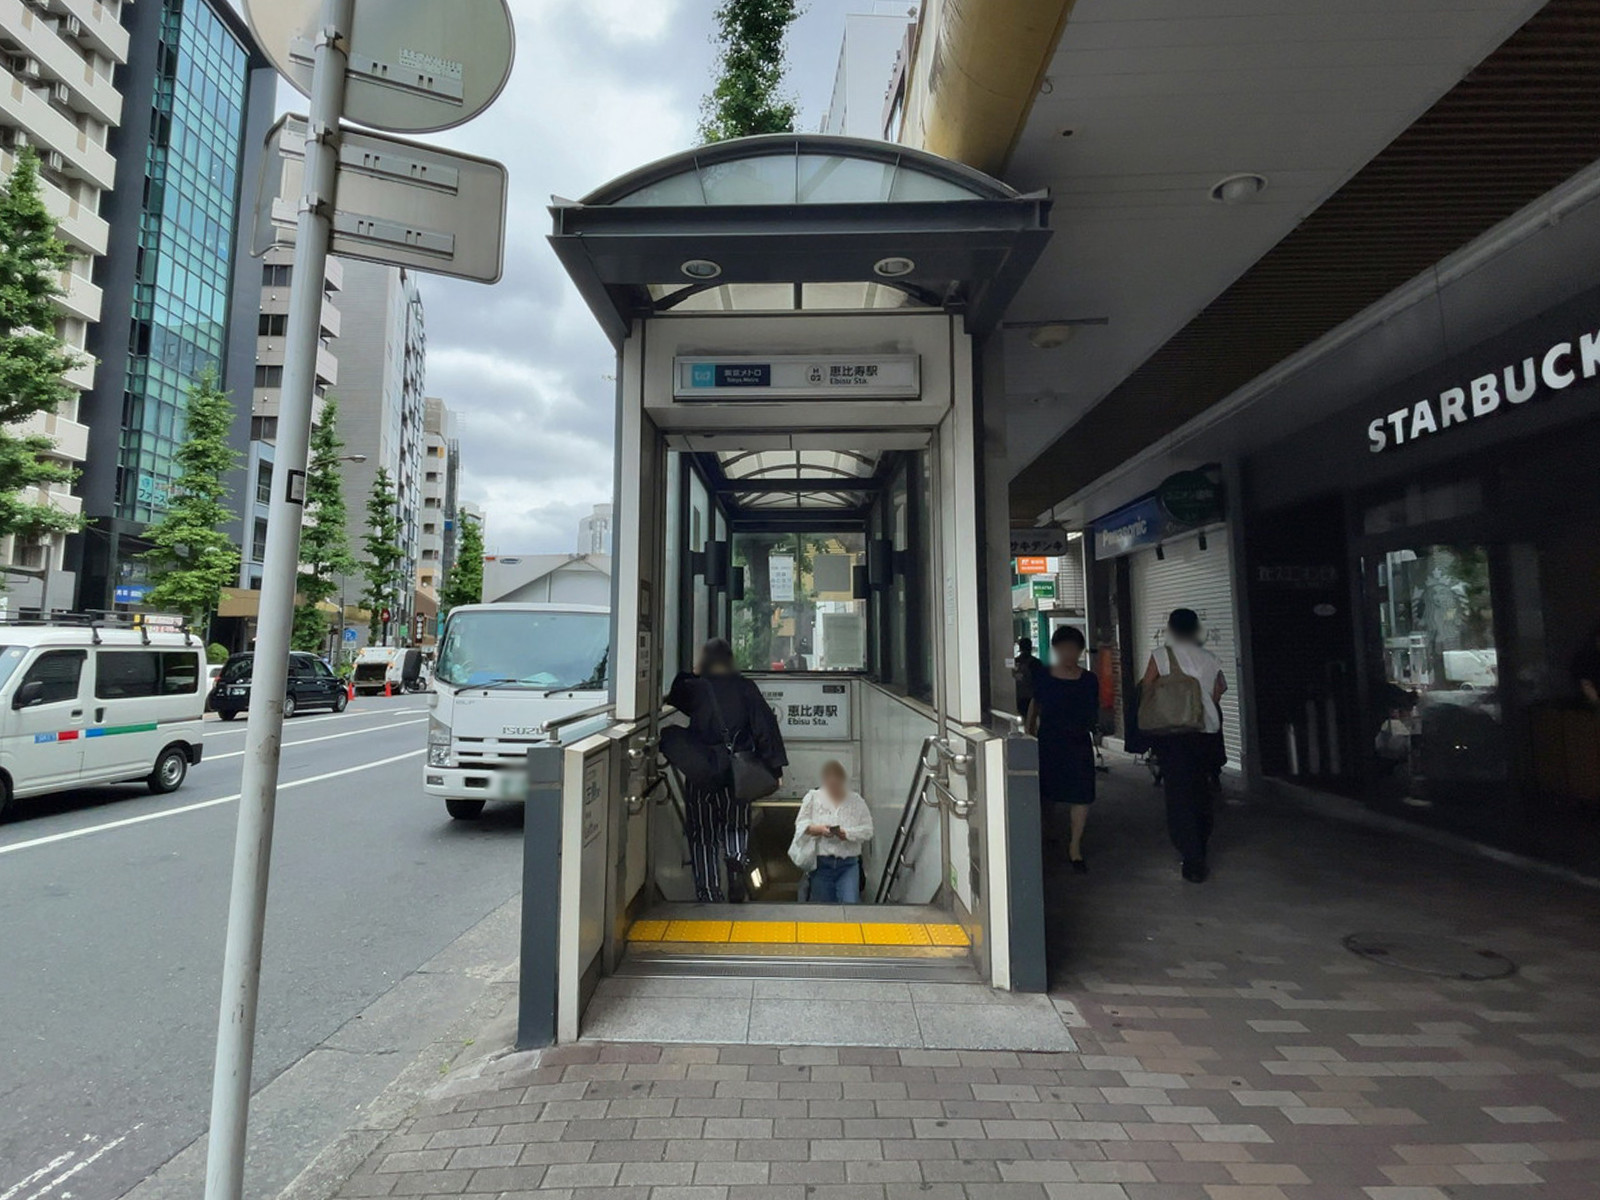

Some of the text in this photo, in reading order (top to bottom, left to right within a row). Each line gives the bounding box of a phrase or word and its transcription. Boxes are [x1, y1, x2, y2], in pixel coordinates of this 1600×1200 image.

[829, 365, 878, 377] 恵比寿駅
[810, 374, 822, 382] 02
[853, 377, 869, 385] Sta.
[1102, 516, 1148, 548] Panasonic
[787, 704, 838, 717] 恵比寿駅
[788, 717, 829, 726] Ebisu Sta.
[502, 725, 545, 735] ISUZU
